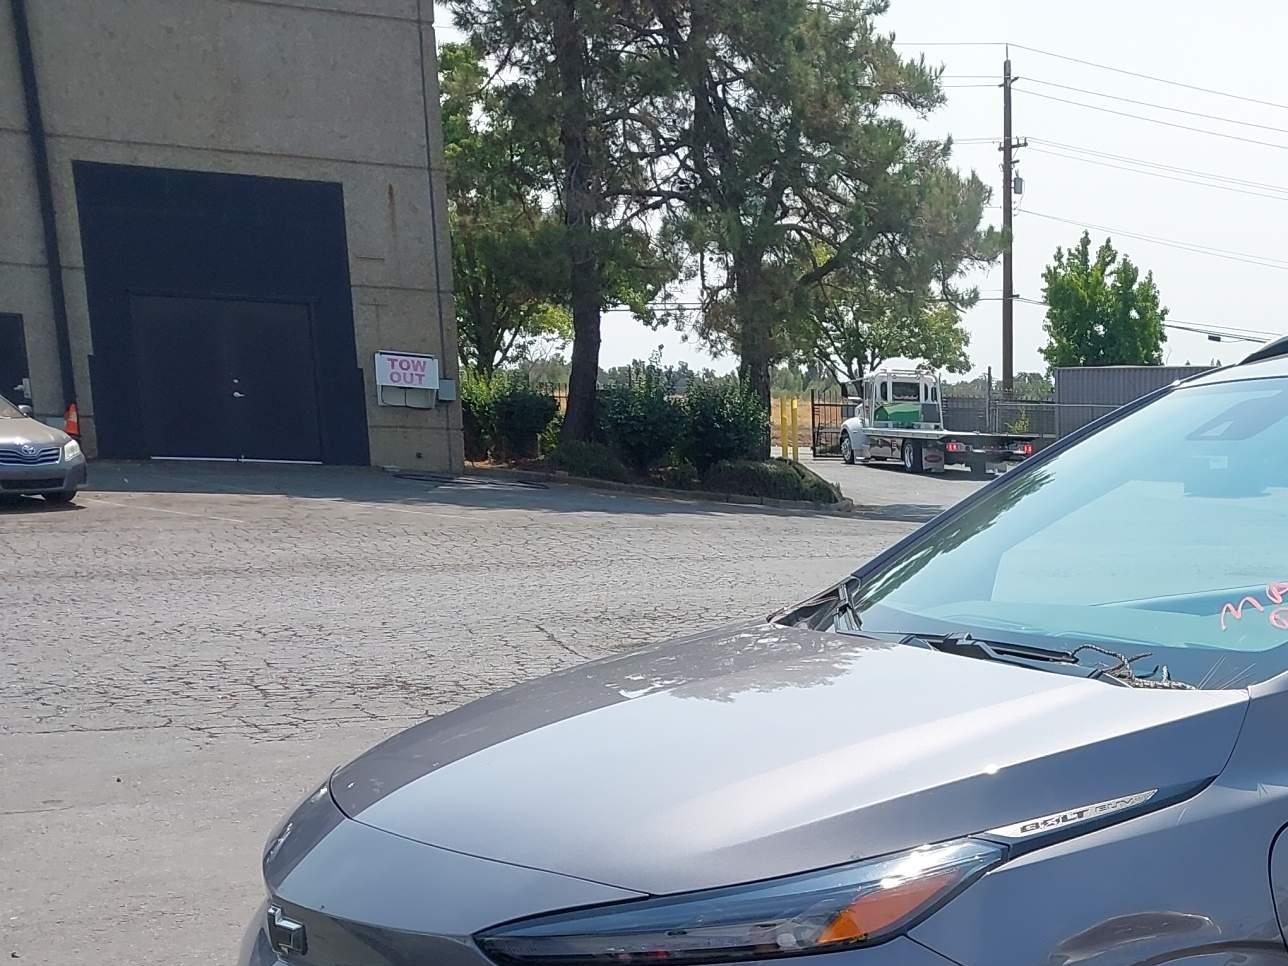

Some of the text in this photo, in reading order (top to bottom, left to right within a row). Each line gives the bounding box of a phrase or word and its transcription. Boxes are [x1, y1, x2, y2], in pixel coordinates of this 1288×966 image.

[387, 358, 426, 372] TOW
[390, 371, 425, 385] OUT
[1020, 809, 1089, 833] BOLT
